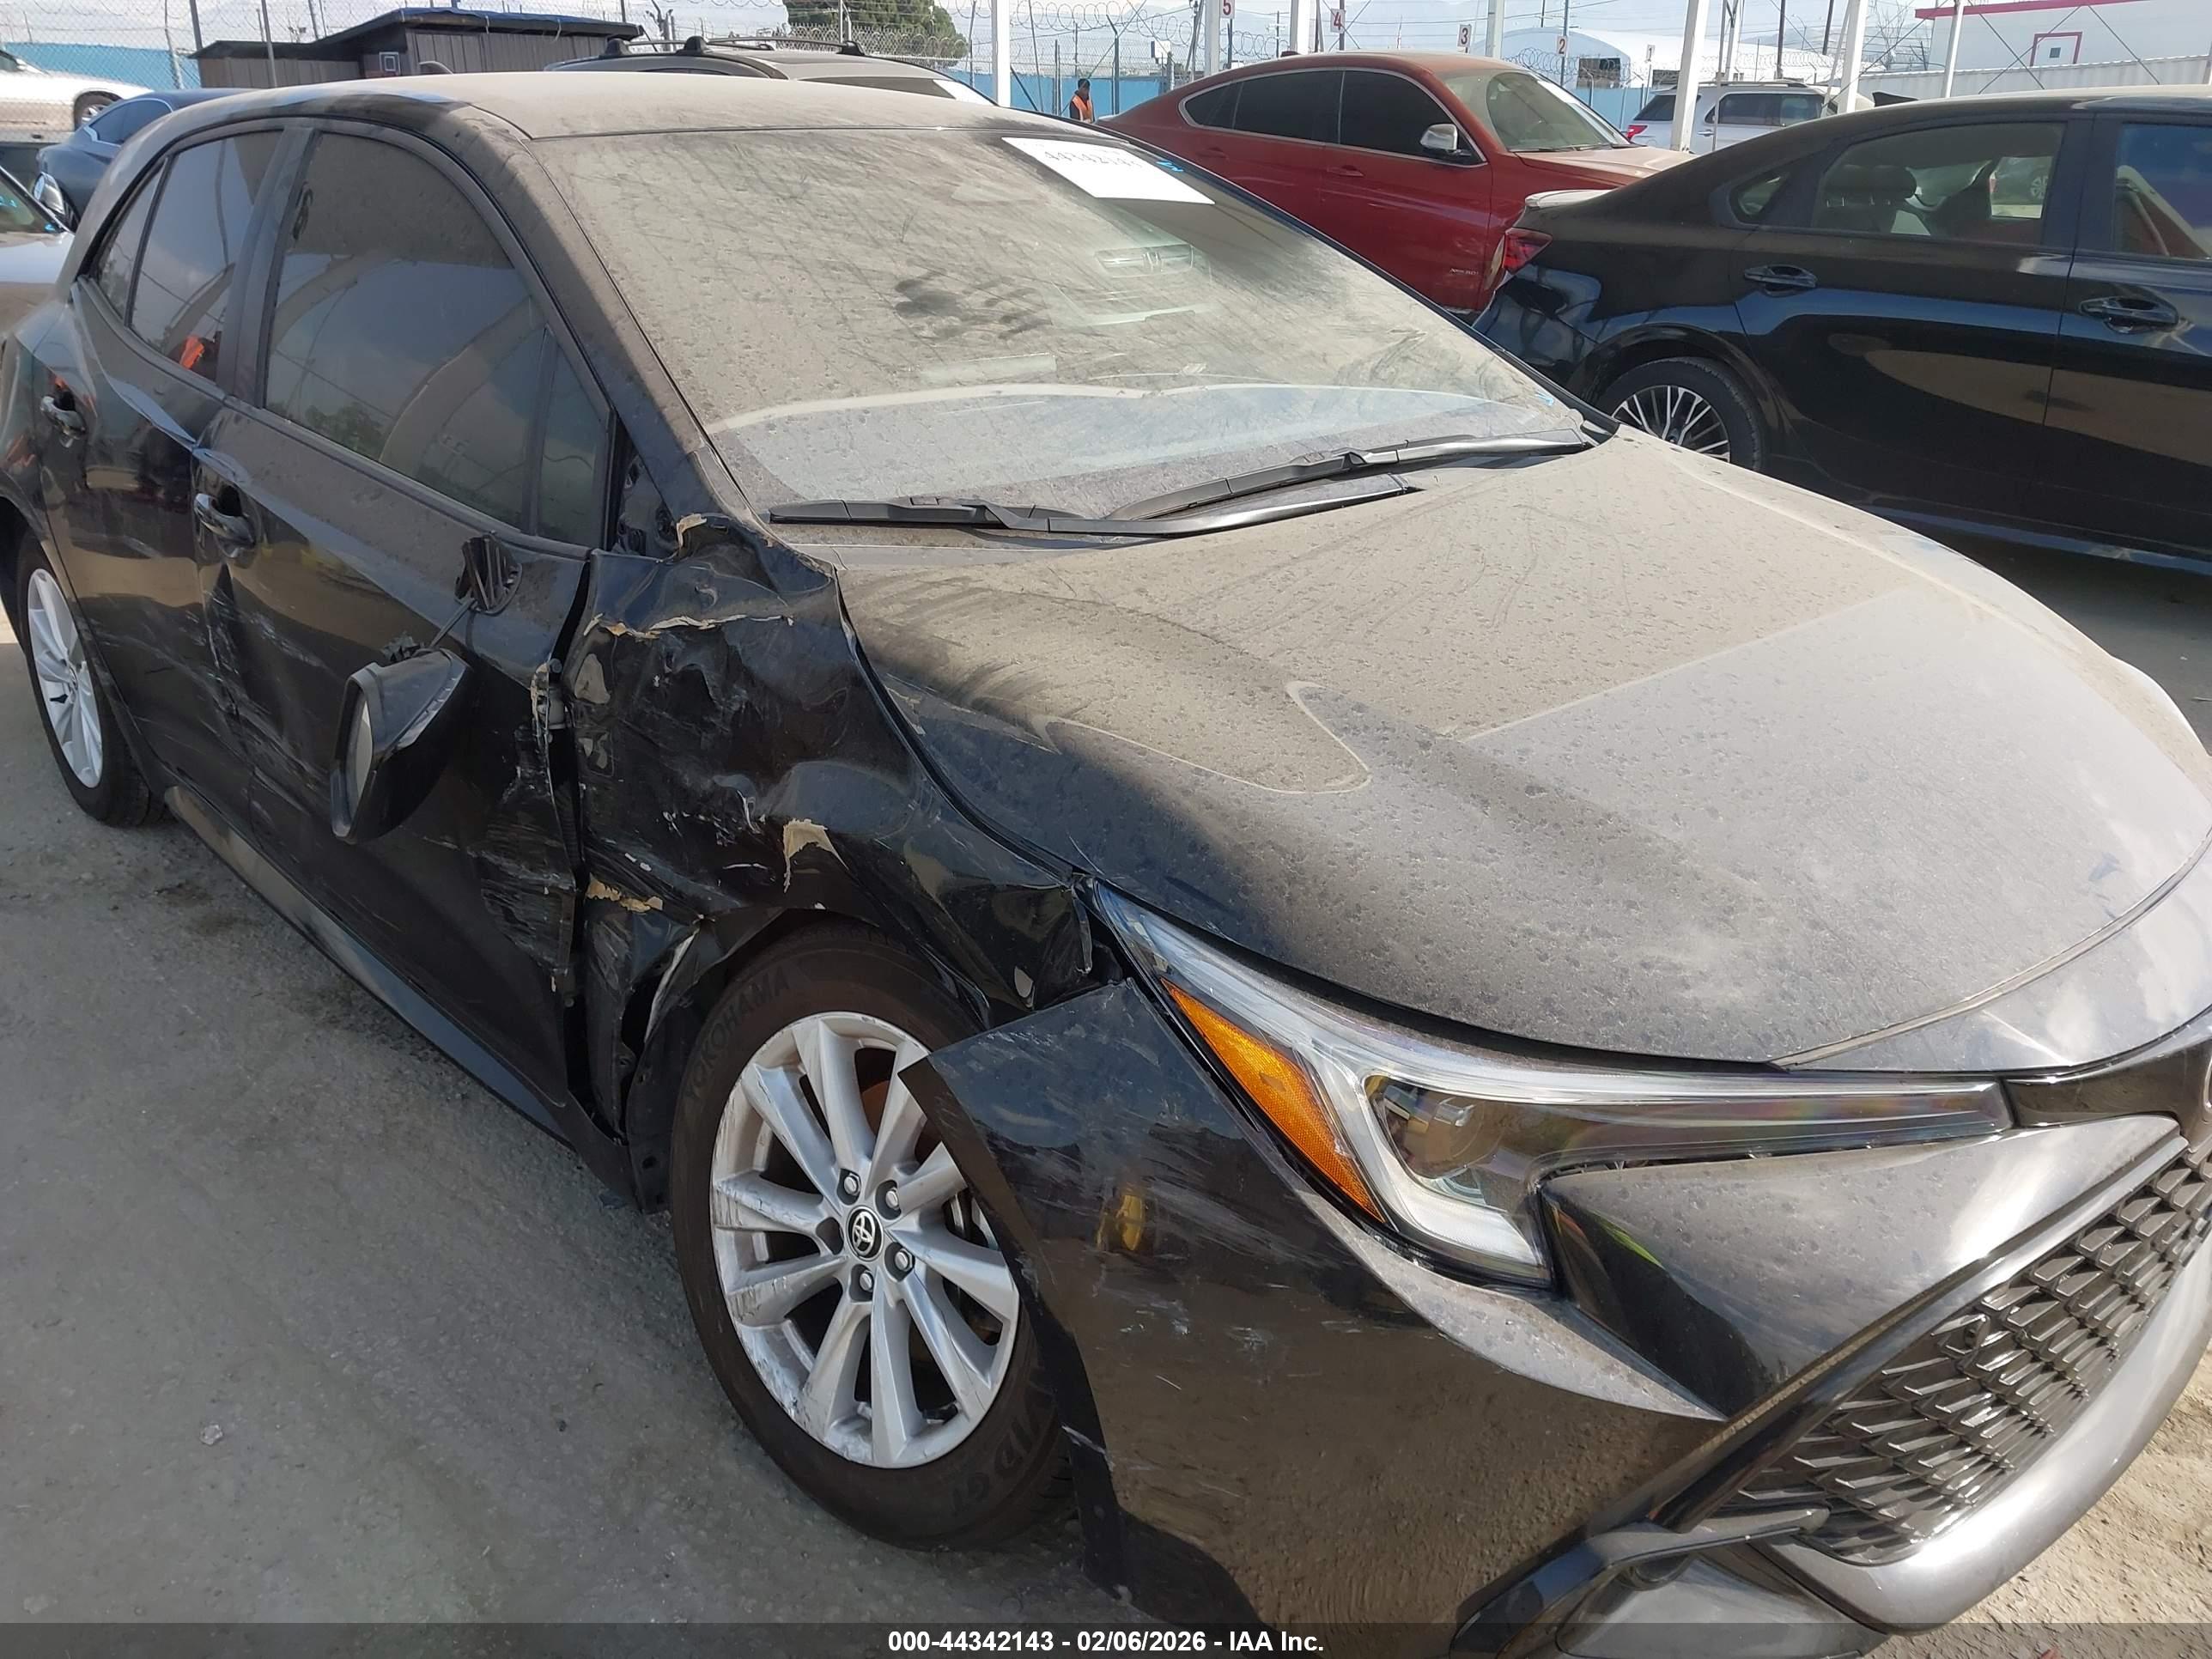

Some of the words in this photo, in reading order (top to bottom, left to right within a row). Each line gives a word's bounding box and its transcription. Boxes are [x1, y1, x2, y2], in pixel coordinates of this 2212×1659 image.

[1223, 0, 1231, 15] 5
[1334, 11, 1342, 30] 4
[1461, 27, 1468, 45] 3
[1559, 38, 1565, 54] 2
[684, 967, 792, 1100] YOKOHAMA
